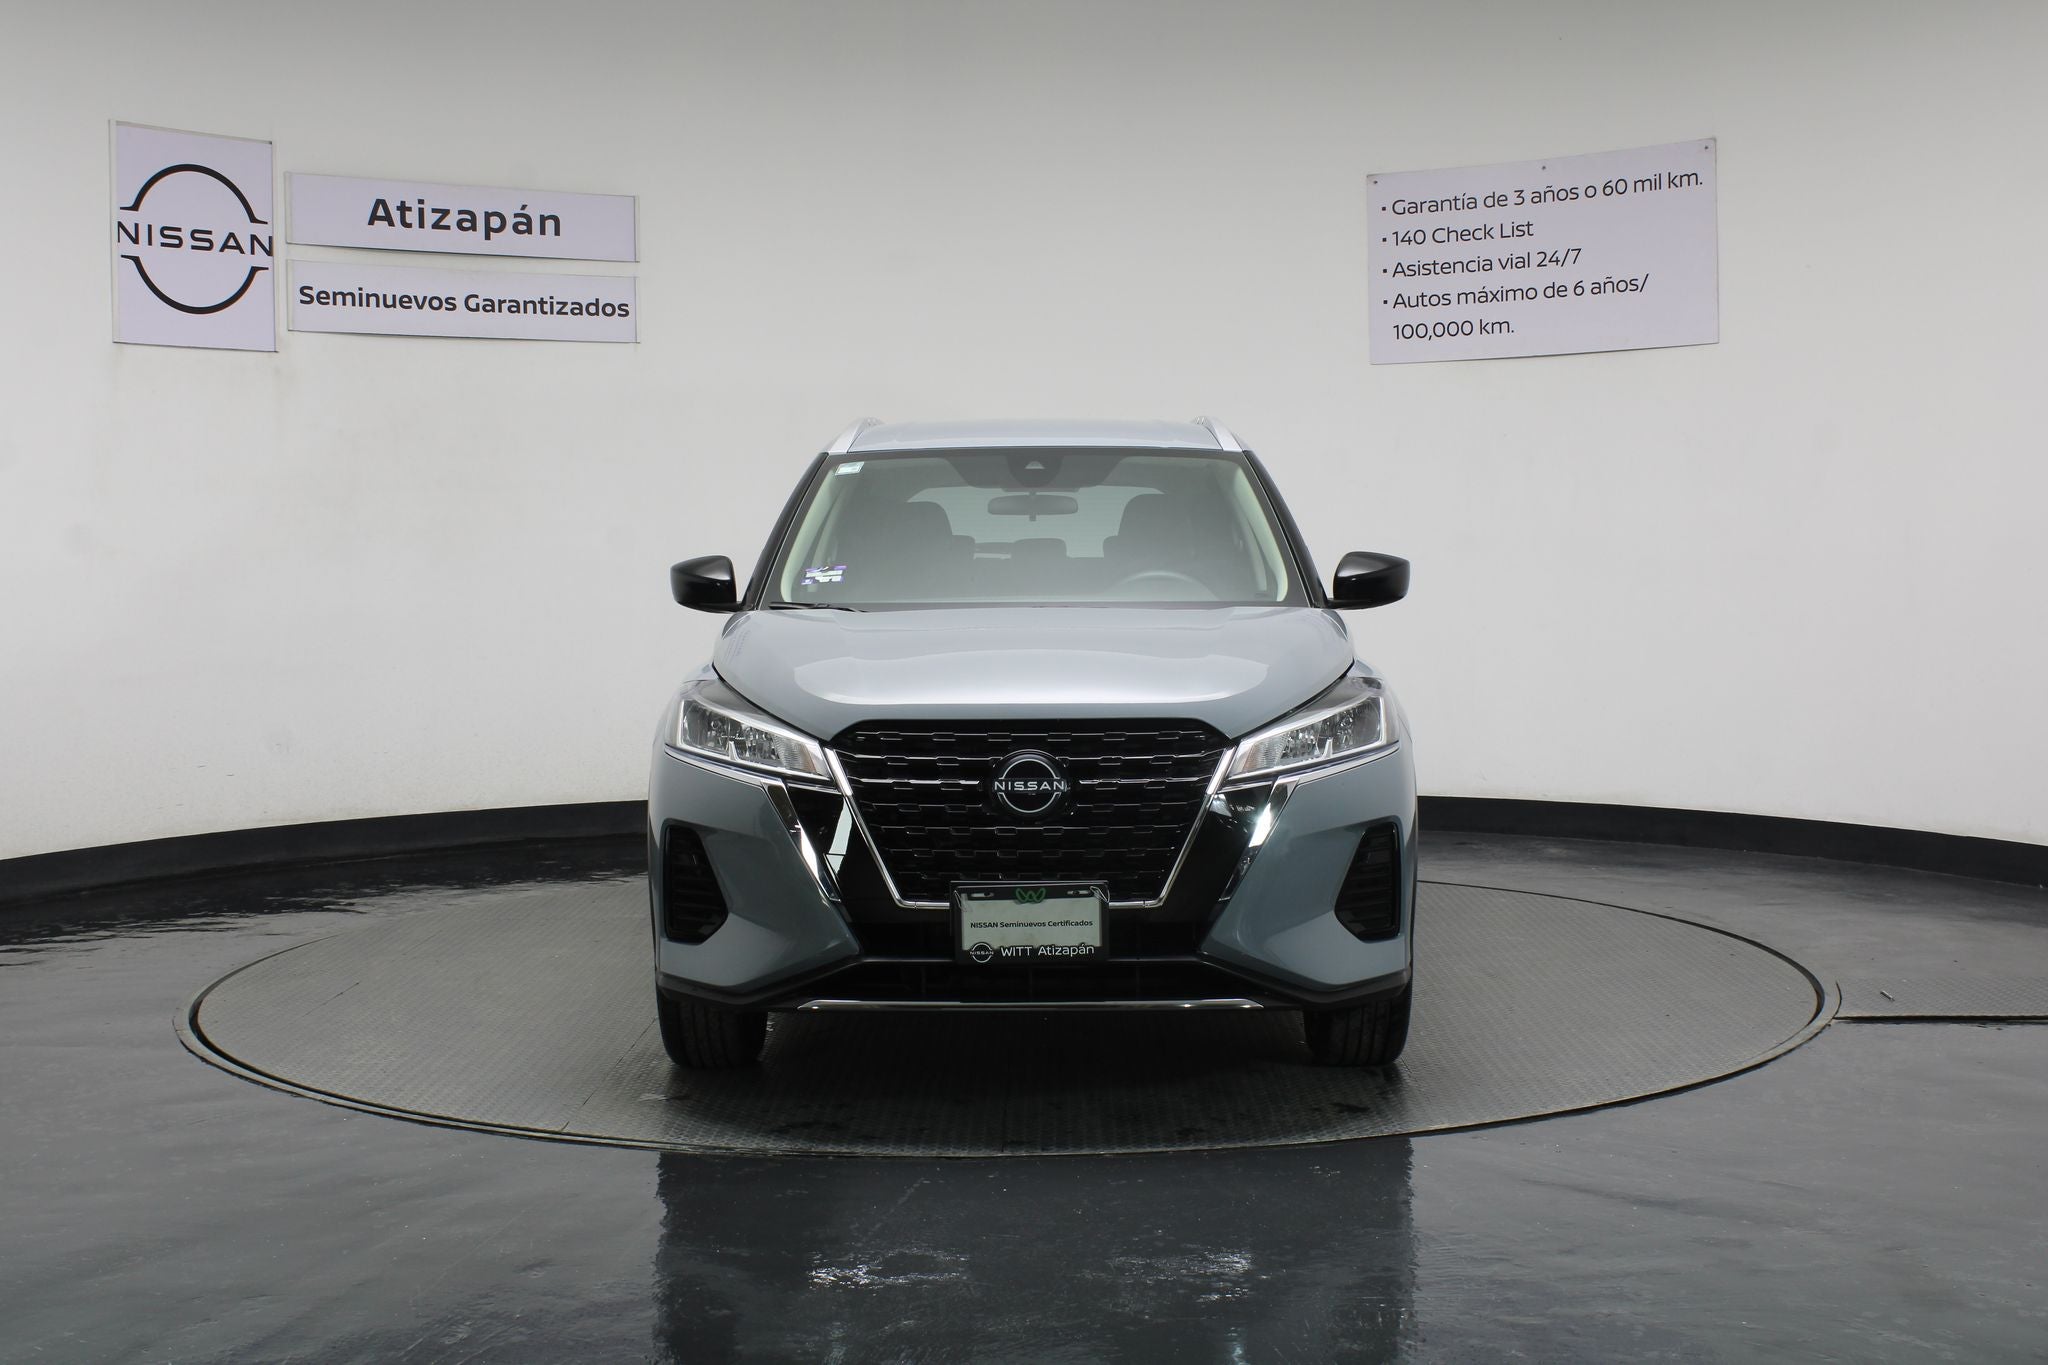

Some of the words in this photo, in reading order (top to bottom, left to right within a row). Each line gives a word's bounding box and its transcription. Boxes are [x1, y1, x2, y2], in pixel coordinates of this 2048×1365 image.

[1391, 192, 1478, 216] Garantía
[1483, 191, 1509, 209] de
[1513, 189, 1526, 206] 3
[1530, 185, 1580, 205] años
[1584, 184, 1598, 199] o
[1602, 178, 1629, 197] 60
[1633, 172, 1662, 193] mil
[1667, 169, 1704, 190] km.
[367, 198, 562, 240] Atizapán
[1391, 228, 1427, 247] 140
[1431, 223, 1495, 244] Check
[1500, 220, 1535, 239] List
[117, 219, 274, 257] NISSAN
[1392, 255, 1494, 278] Asistencia
[1497, 251, 1531, 271] vial
[1536, 247, 1582, 269] 24/7
[299, 285, 458, 312] Seminuevos
[463, 293, 631, 318] Garantizados
[1392, 291, 1452, 309] Autos
[1456, 285, 1538, 306] máximo
[1543, 281, 1568, 299] de
[1573, 279, 1585, 297] 6
[1590, 273, 1650, 297] años/
[1392, 319, 1474, 341] 100,000
[1479, 318, 1515, 336] km.
[994, 780, 1066, 791] NISSAN
[970, 921, 999, 929] NISSAN
[1000, 920, 1046, 929] Seminuevos
[1047, 919, 1093, 927] Certificados
[1001, 945, 1032, 957] WITT
[1038, 943, 1095, 957] Atizapán
